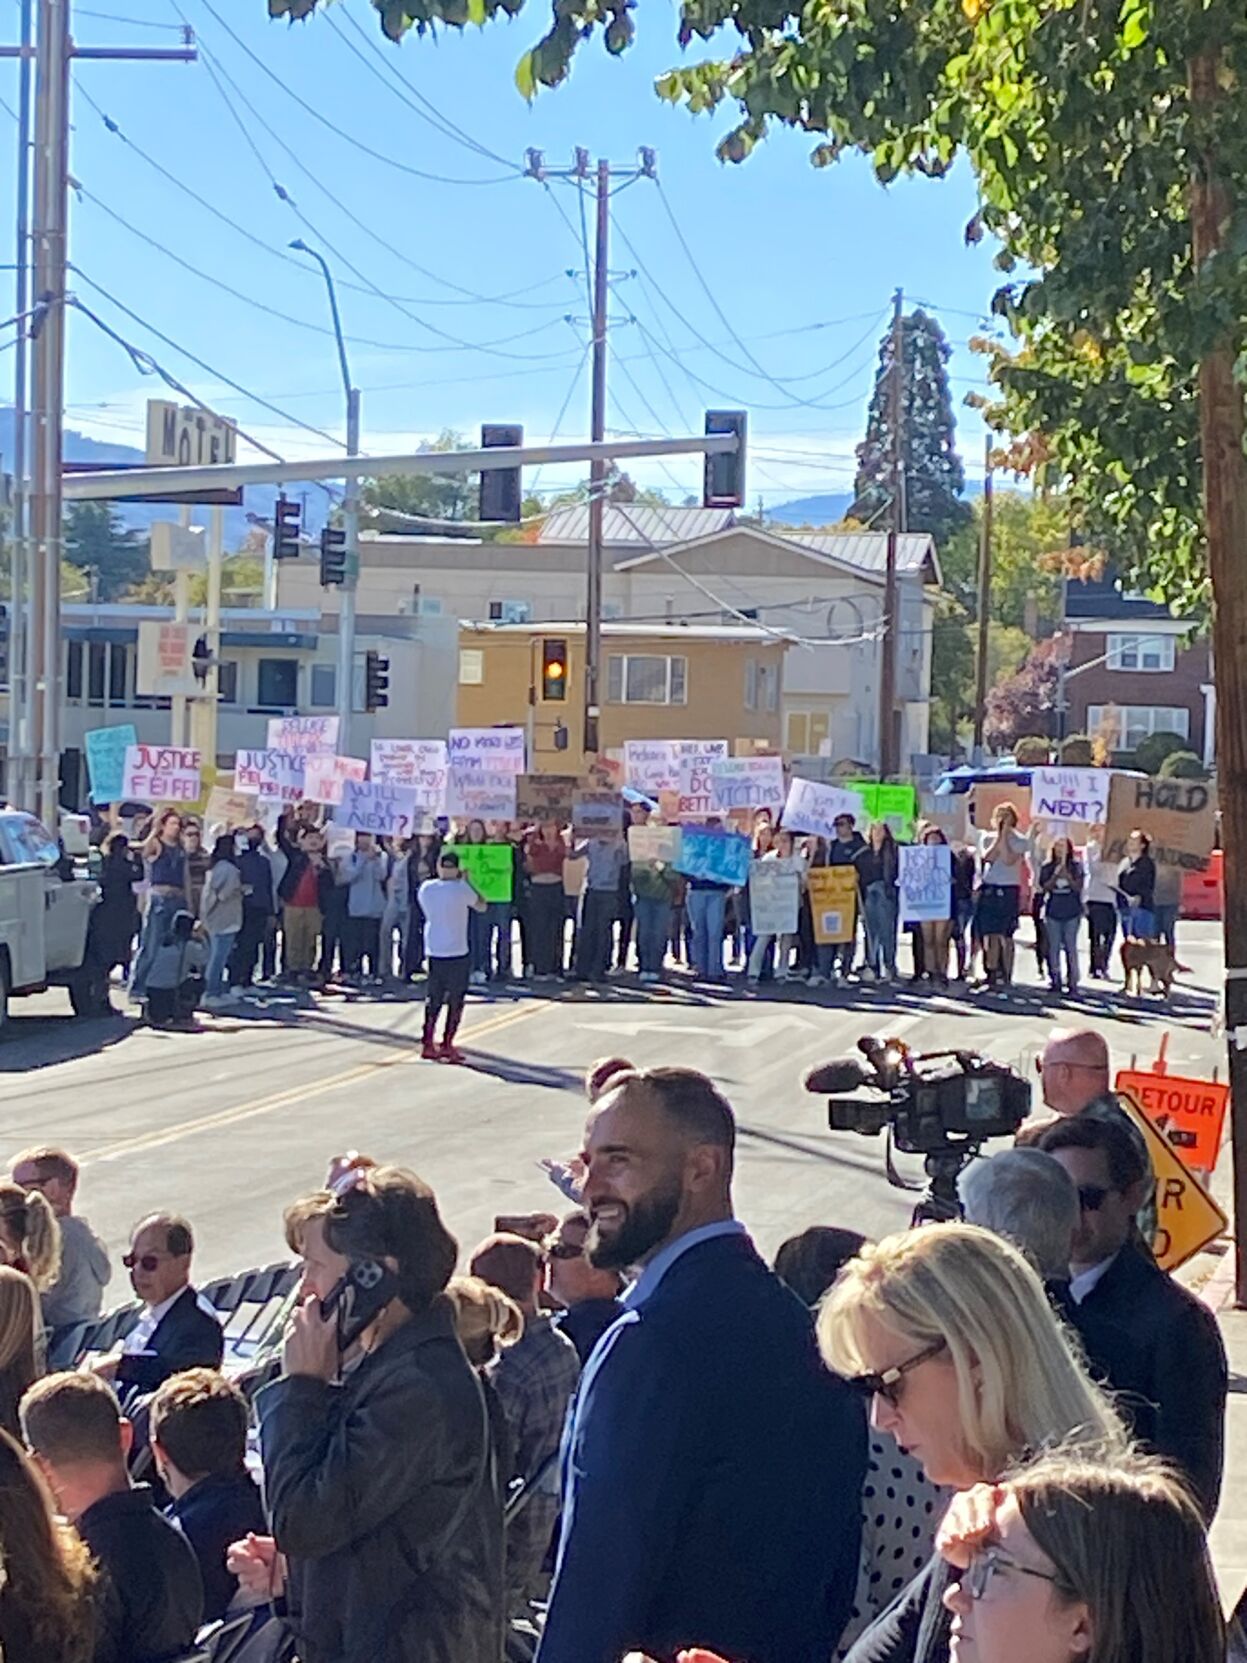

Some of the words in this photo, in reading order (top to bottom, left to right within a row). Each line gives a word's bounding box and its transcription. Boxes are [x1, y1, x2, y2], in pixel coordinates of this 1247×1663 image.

[451, 736, 471, 749] NO
[132, 745, 202, 770] JUSTICE
[239, 749, 307, 773] JUSTICE
[131, 775, 168, 796] FEI
[171, 778, 198, 800] FEI
[350, 781, 402, 801] WILL
[1038, 798, 1104, 822] NEXT?
[346, 811, 409, 836] NEXT?
